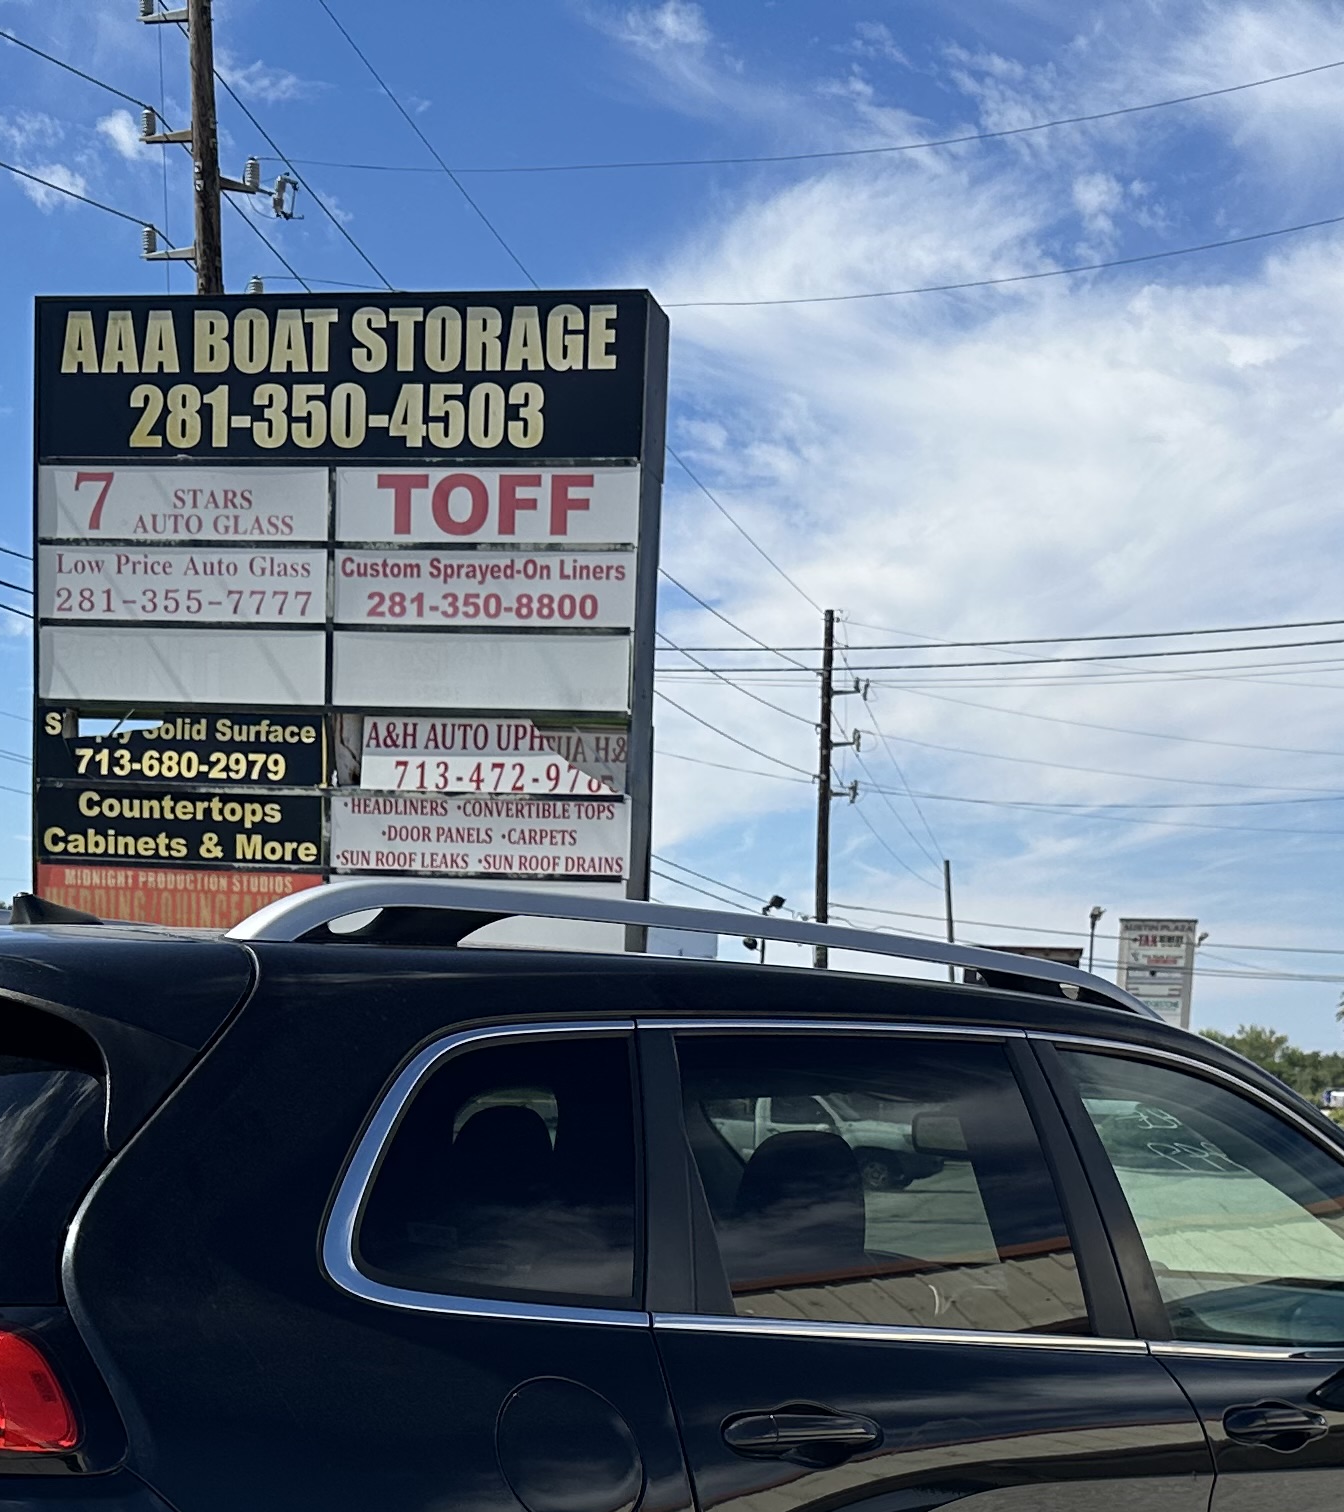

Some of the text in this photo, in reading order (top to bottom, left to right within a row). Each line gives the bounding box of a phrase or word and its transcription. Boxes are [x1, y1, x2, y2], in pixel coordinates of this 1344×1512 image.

[61, 304, 617, 373] AAA BOAT STORAGE
[129, 382, 545, 449] 281-350-4503
[73, 472, 115, 530] 7
[172, 488, 253, 510] STARS
[377, 473, 595, 536] TOFF
[132, 514, 294, 537] AUTO GLASS
[56, 554, 312, 580] Low Price Auto Glass
[340, 557, 626, 584] Custom Sprayed-On Liners
[56, 588, 313, 617] 281-355-7777
[367, 591, 599, 621] 281-350-8800
[215, 719, 317, 745] Surface
[365, 721, 417, 750] A&H
[423, 722, 489, 751] AUTO
[74, 748, 287, 781] 713-680-2979
[78, 791, 283, 828] Countertops
[351, 799, 616, 821] HEADLINERS CONVERTIBLE TOPS
[43, 826, 318, 862] Cabinets & More
[387, 825, 578, 847] DOOR PANELS CARPETS
[340, 849, 624, 874] SUN ROOF LEAKS SUN ROOF DRAINS
[64, 868, 294, 895] MIDNIGHT PRODUCTION STUDIOS
